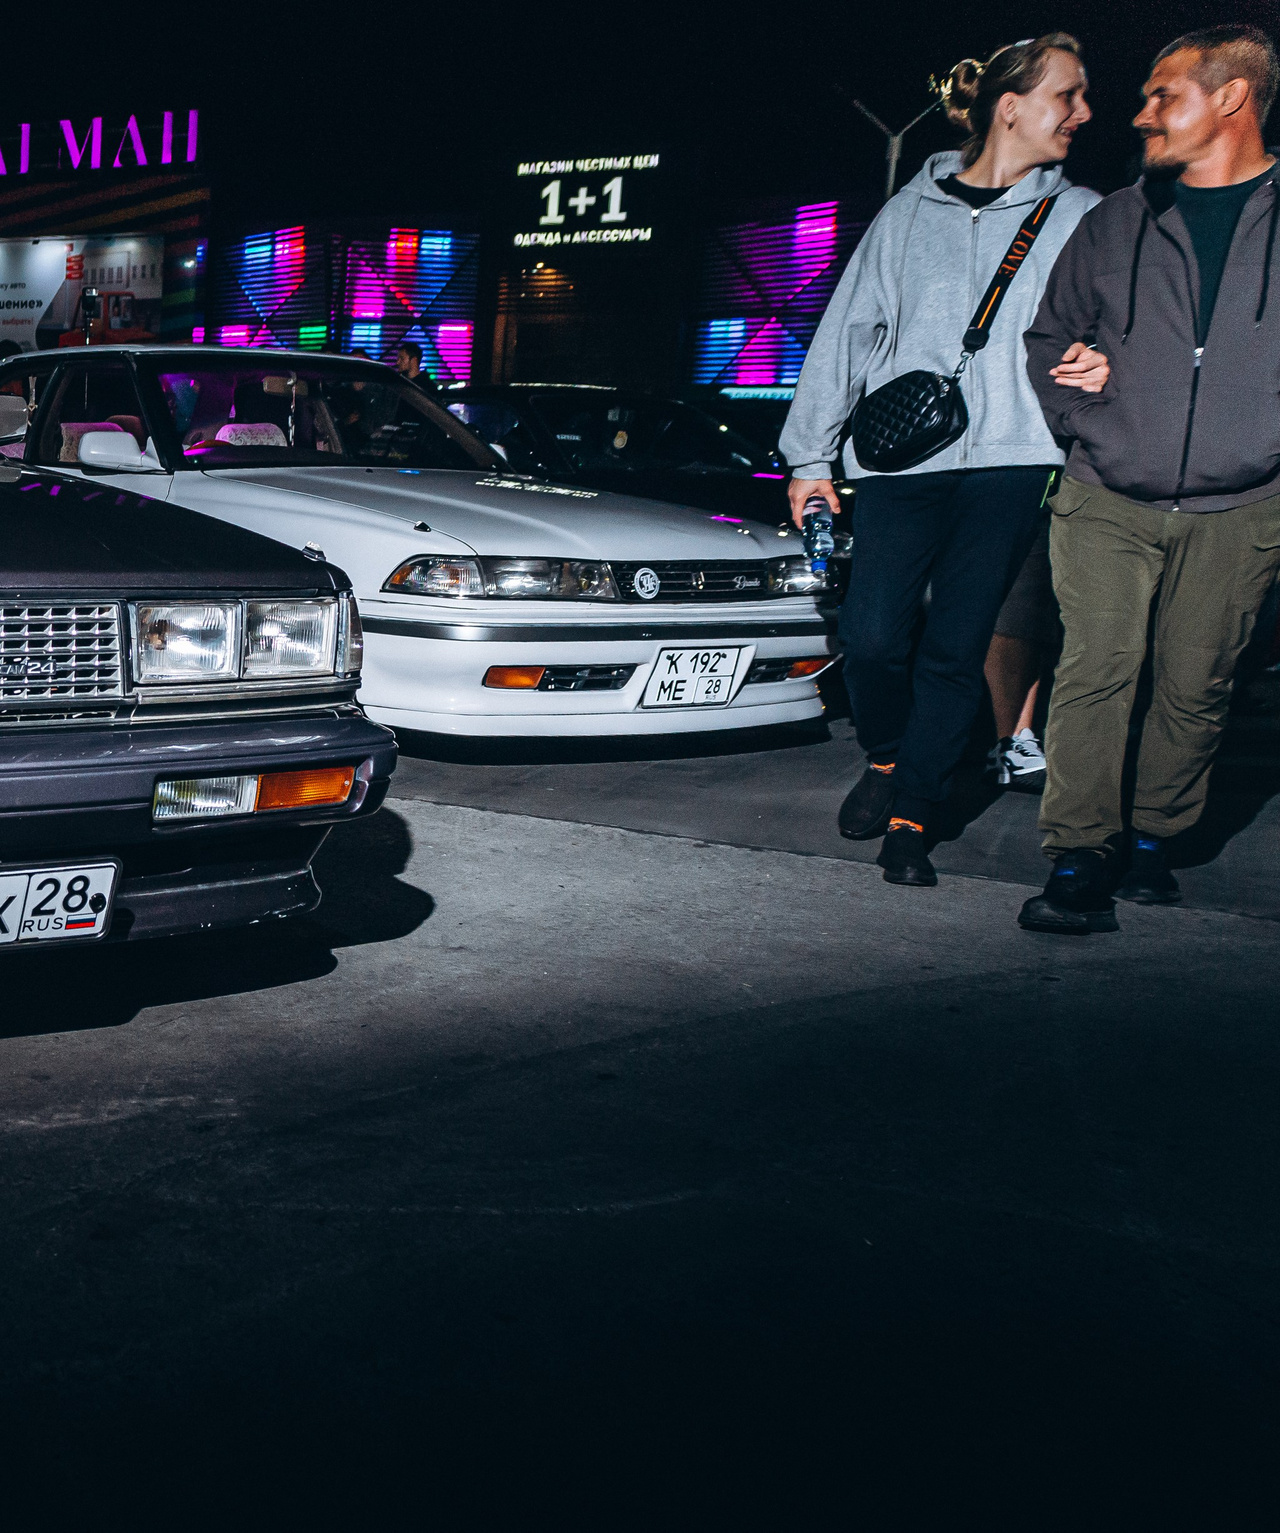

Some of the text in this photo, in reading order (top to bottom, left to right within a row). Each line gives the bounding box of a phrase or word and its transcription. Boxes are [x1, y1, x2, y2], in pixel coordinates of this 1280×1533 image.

[517, 154, 660, 176] МАГАЗИН ЧЕСТНЫХ ЦЕН
[539, 176, 627, 226] 1+1
[514, 227, 652, 247] ОДЕЖДА и АКСЕССУАРЫ
[998, 228, 1036, 278] LOVE
[9, 282, 27, 290] авто
[27, 661, 54, 675] 24
[705, 679, 722, 695] 28
[31, 874, 91, 917] 28
[21, 915, 64, 934] RUS
